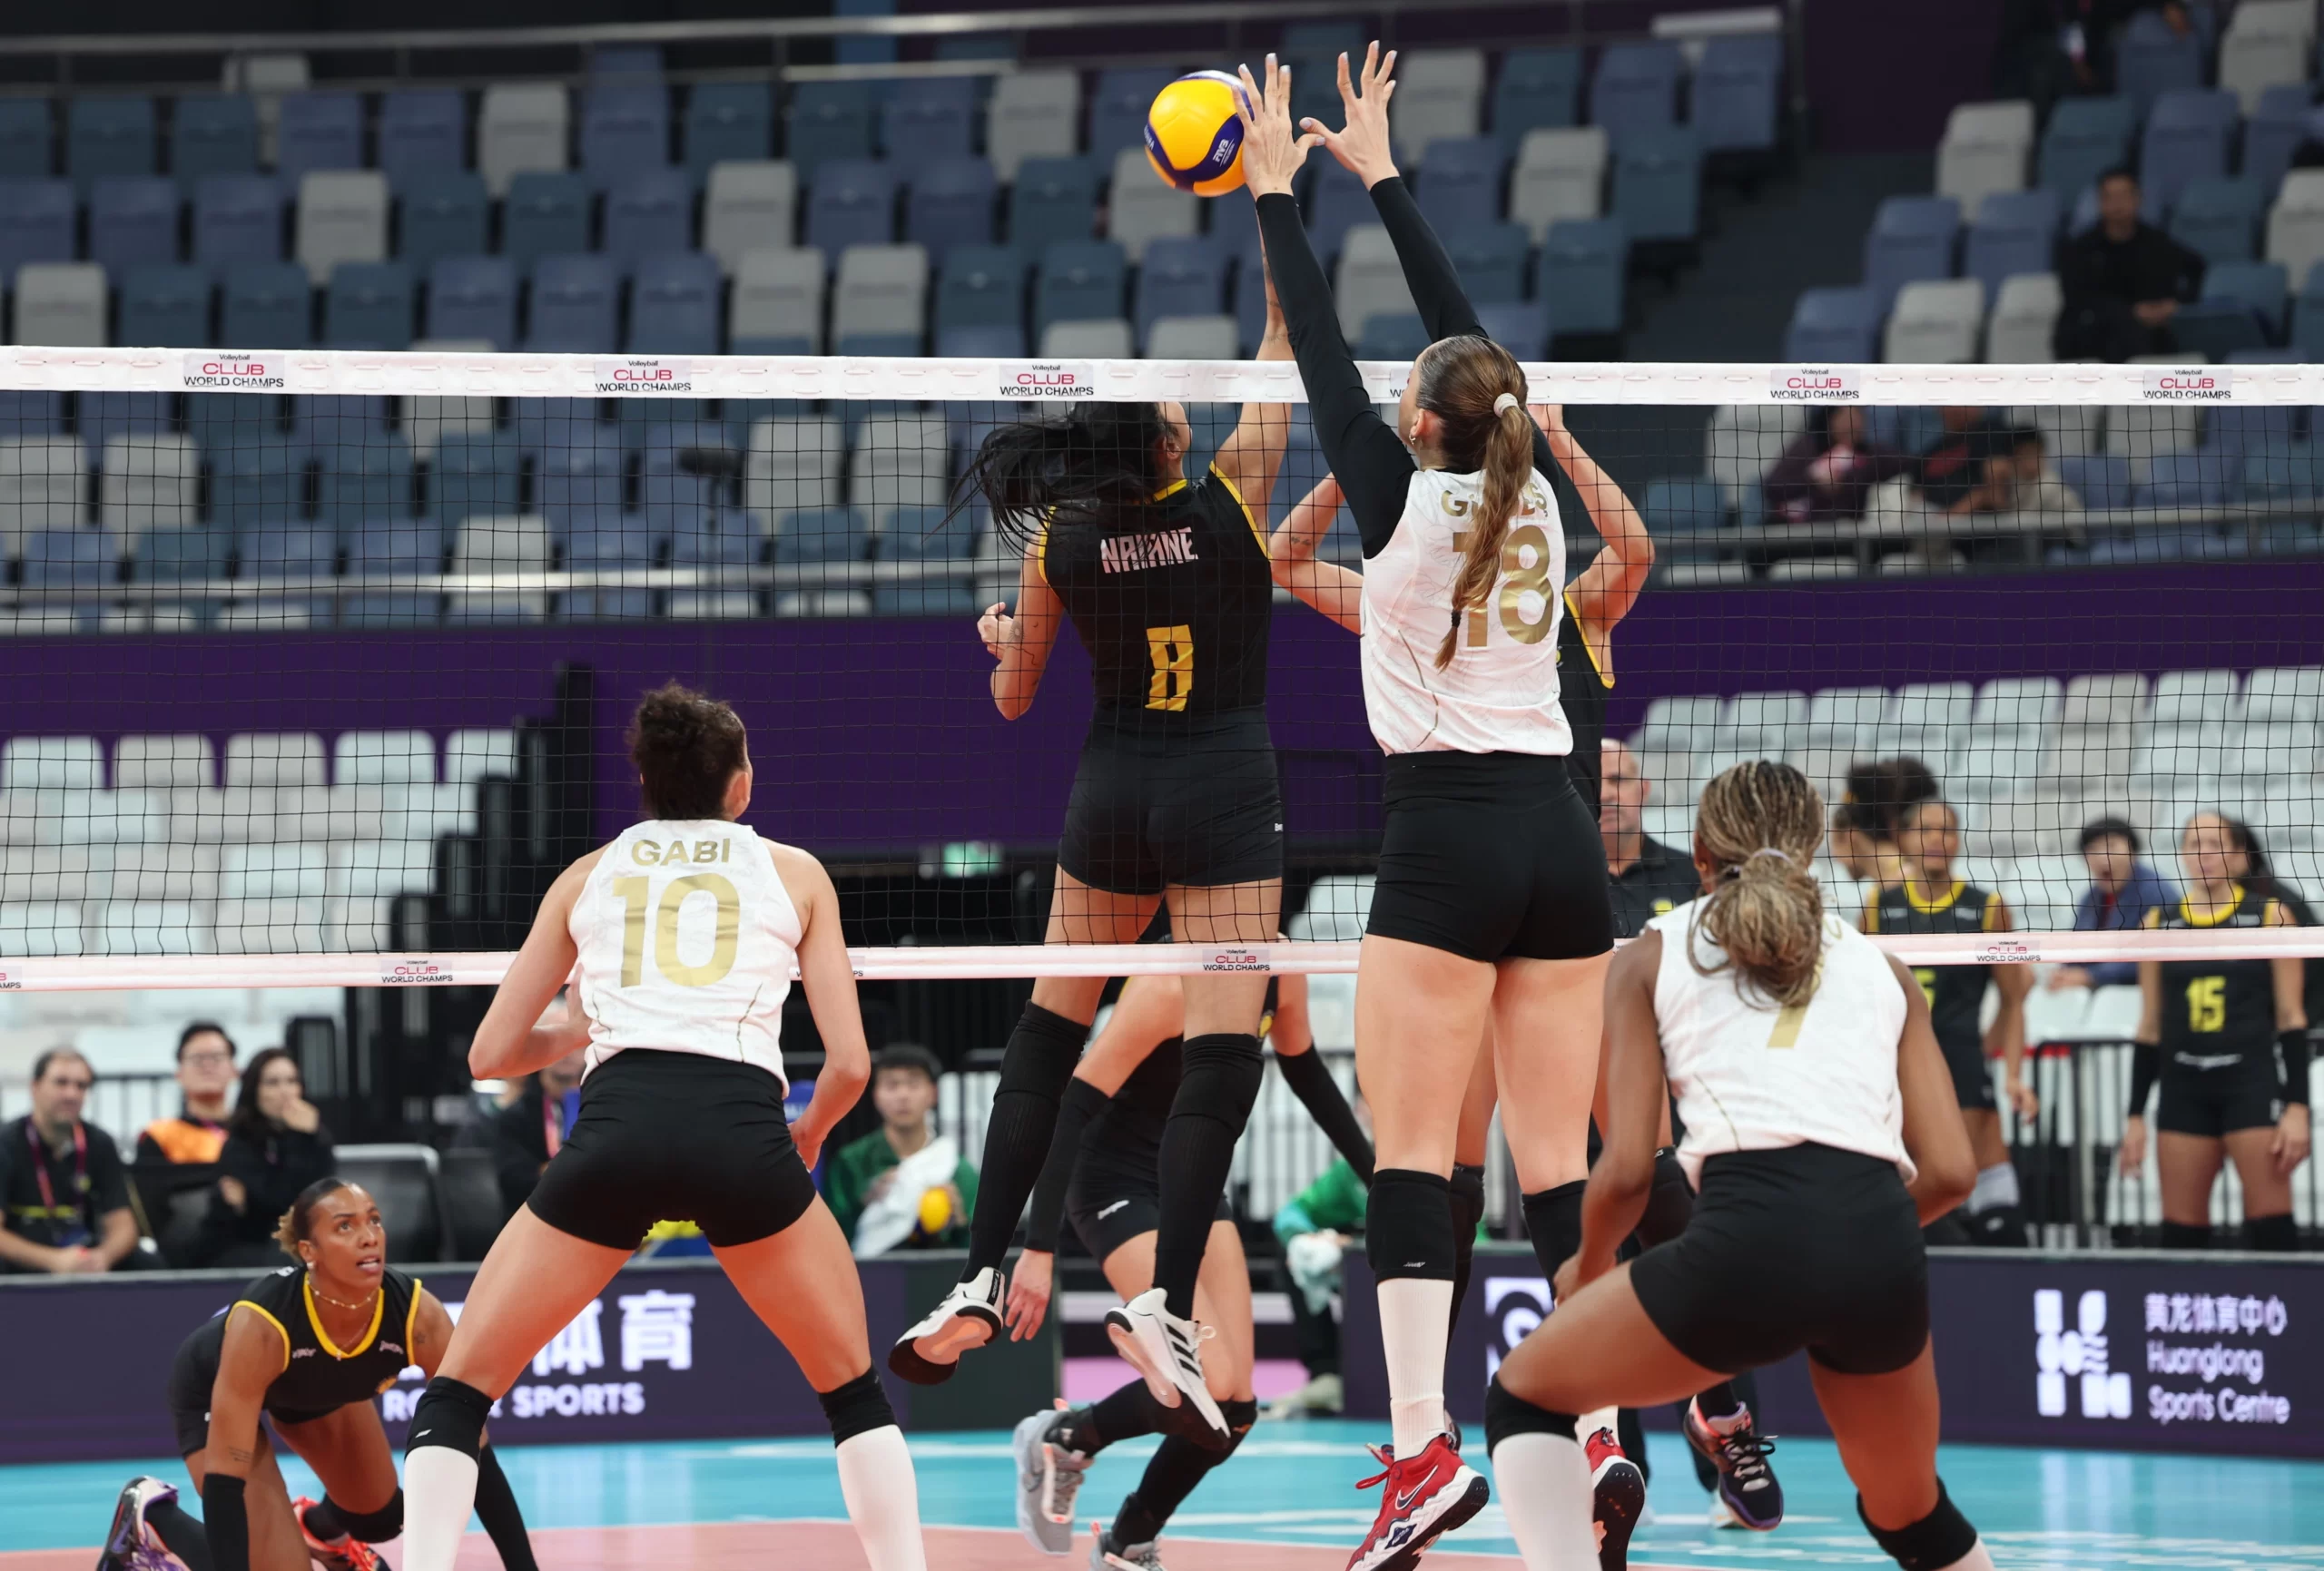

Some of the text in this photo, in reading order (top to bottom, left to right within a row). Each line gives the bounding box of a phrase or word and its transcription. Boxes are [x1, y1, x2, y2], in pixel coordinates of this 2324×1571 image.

[203, 363, 264, 375] CLUB
[614, 369, 672, 380] CLUB
[184, 377, 283, 388] WORLD CHAMPS
[1017, 373, 1075, 385] CLUB
[1787, 378, 1841, 388] CLUB
[2160, 378, 2214, 388] CLUB
[596, 383, 691, 391] WORLD CHAMPS
[1000, 387, 1094, 396] WORLD CHAMPS
[1770, 390, 1859, 398] WORLD CHAMPS
[2143, 390, 2230, 399] WORLD CHAMPS
[1145, 624, 1194, 712] 8
[632, 838, 730, 866] GABI
[612, 872, 740, 988] 10
[395, 967, 438, 975] CLUB
[2185, 976, 2226, 1033] 15
[2146, 1340, 2263, 1384] Huanglong
[512, 1382, 645, 1419] SPORTS
[2148, 1384, 2290, 1425] Sports Centre
